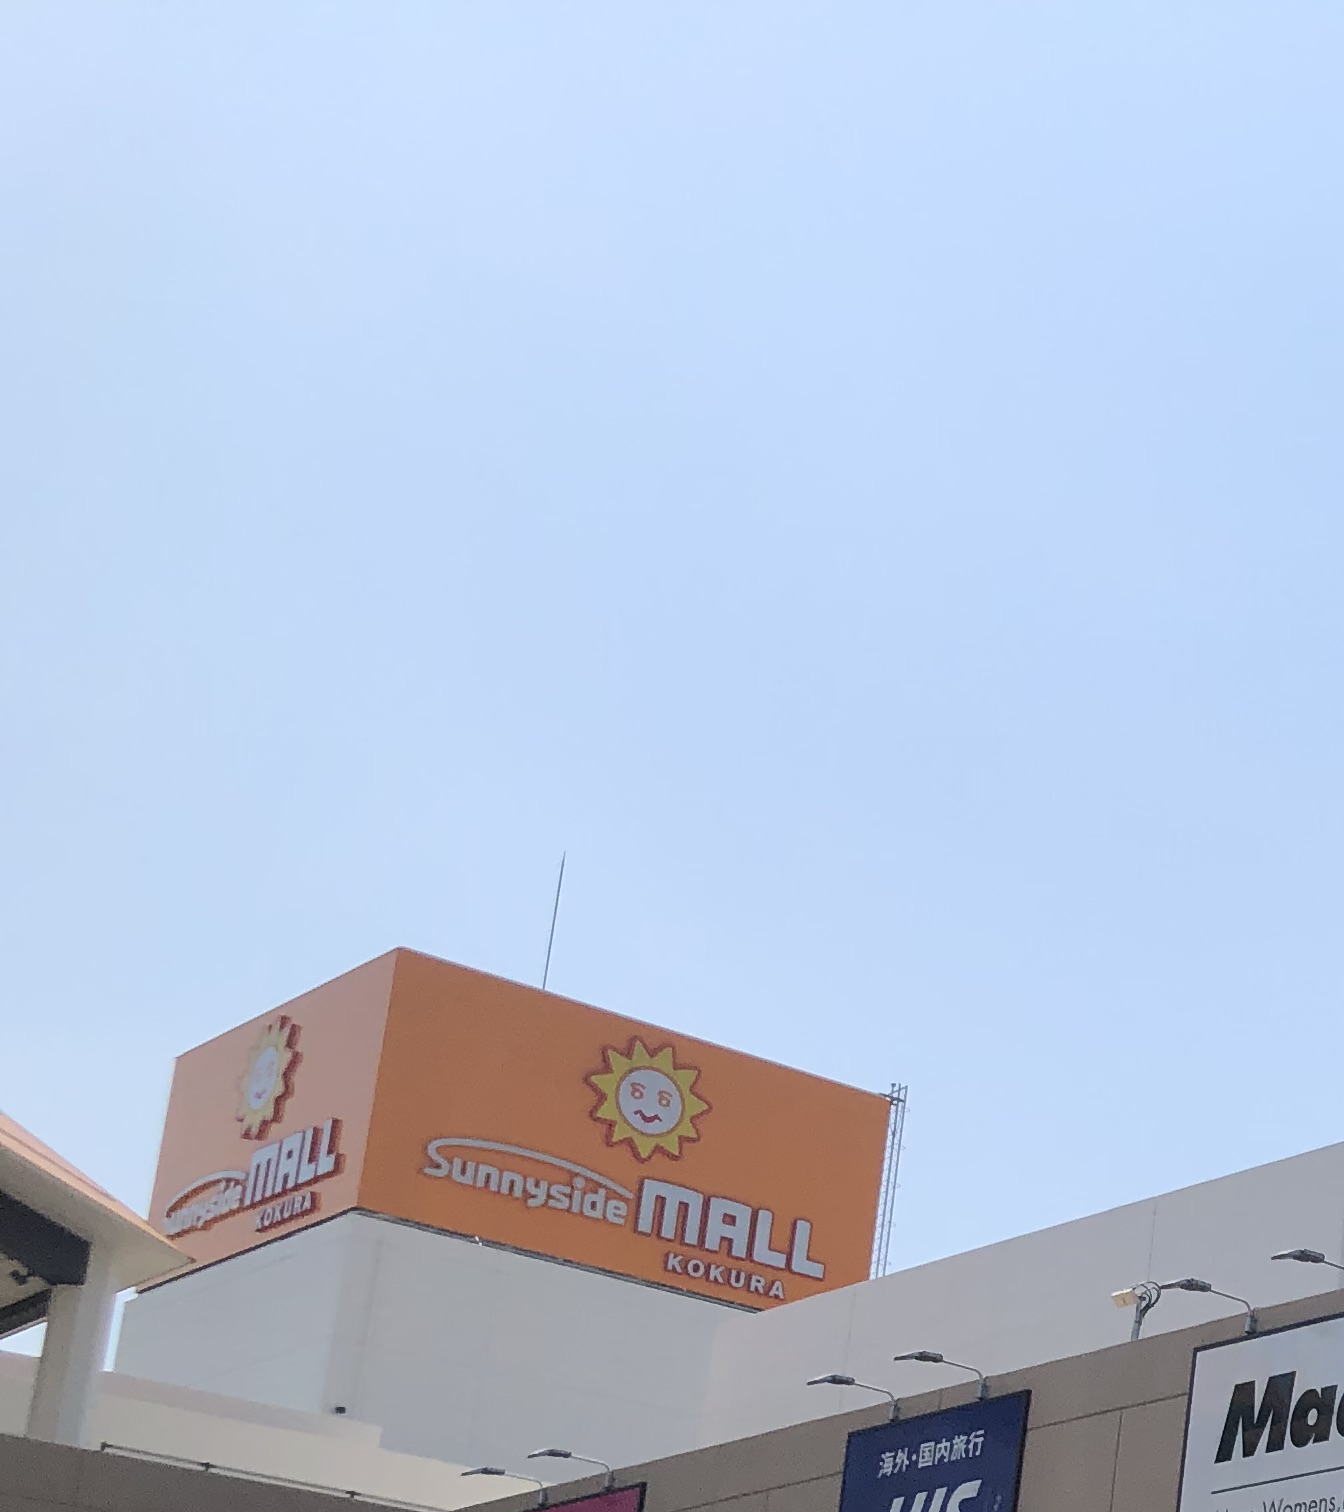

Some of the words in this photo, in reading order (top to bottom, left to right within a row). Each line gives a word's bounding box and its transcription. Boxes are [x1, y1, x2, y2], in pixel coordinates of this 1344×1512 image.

[245, 1118, 337, 1206] MALL
[255, 1191, 313, 1231] KOKURA
[423, 1137, 635, 1226] Sunnyside
[635, 1178, 826, 1280] MALL
[665, 1251, 786, 1300] KOKURA
